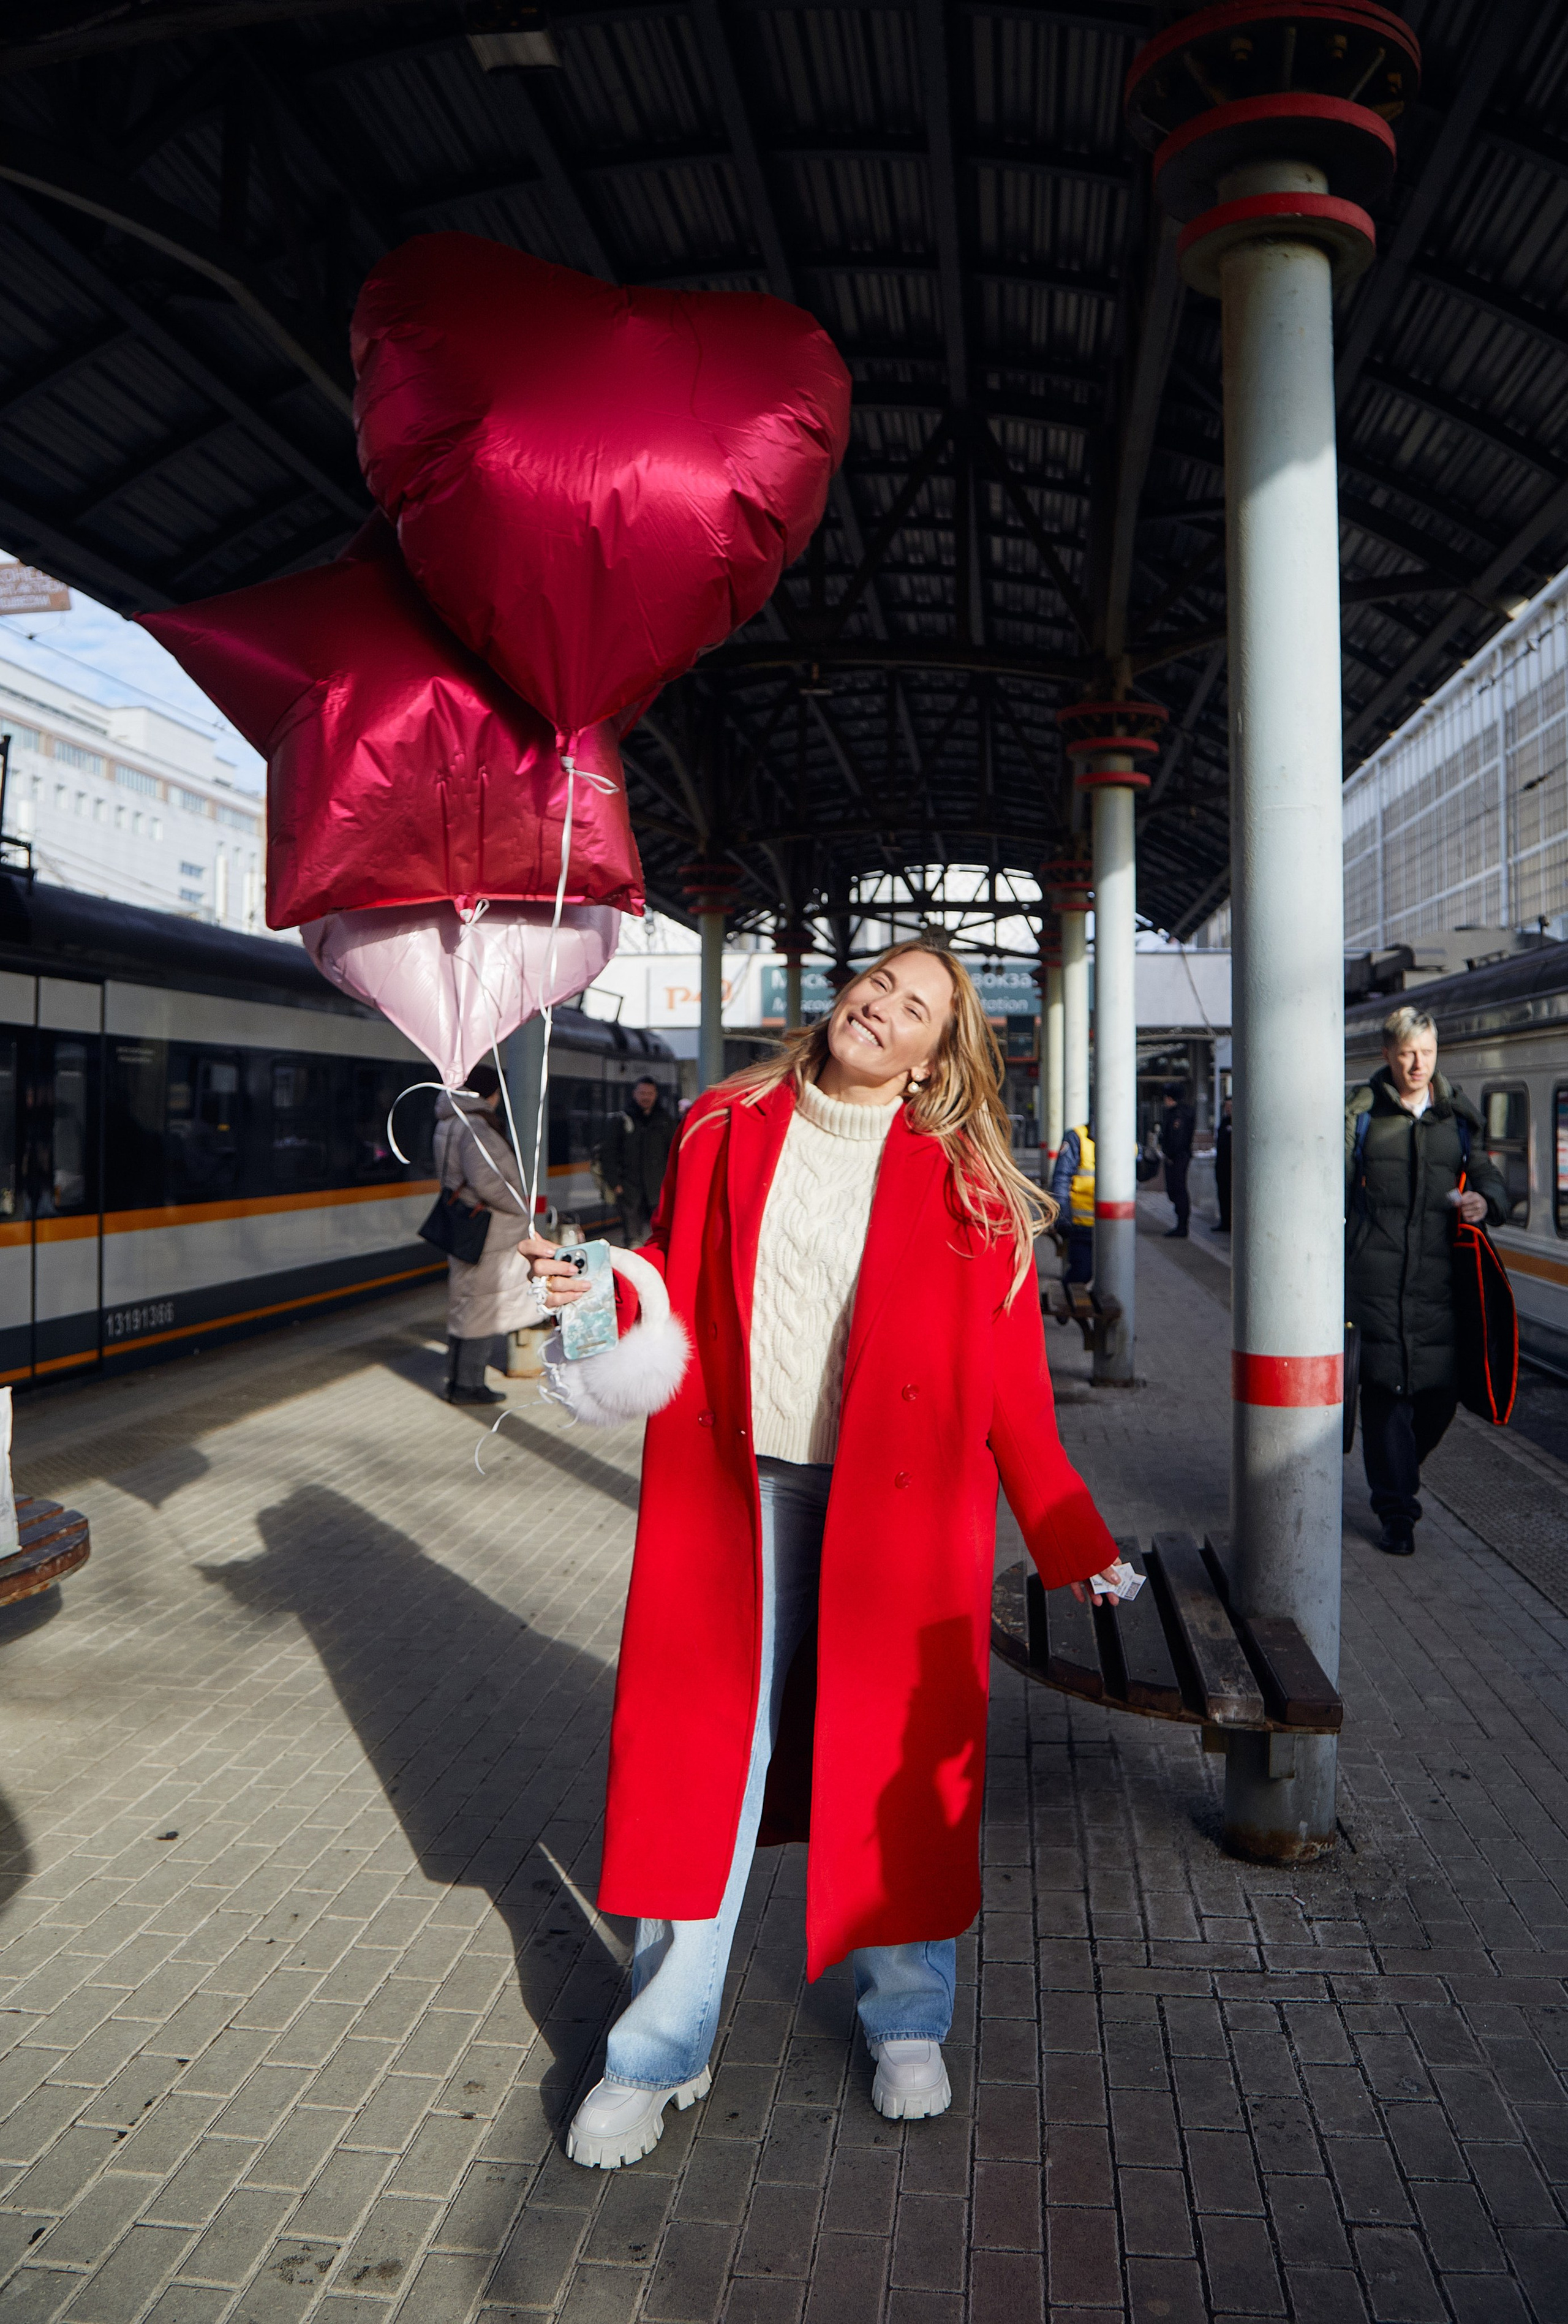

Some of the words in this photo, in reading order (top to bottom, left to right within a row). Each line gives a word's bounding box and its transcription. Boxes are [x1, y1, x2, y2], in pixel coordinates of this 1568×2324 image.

[971, 973, 1038, 989] вокза
[772, 997, 835, 1013] Mscow
[981, 997, 1028, 1013] tation
